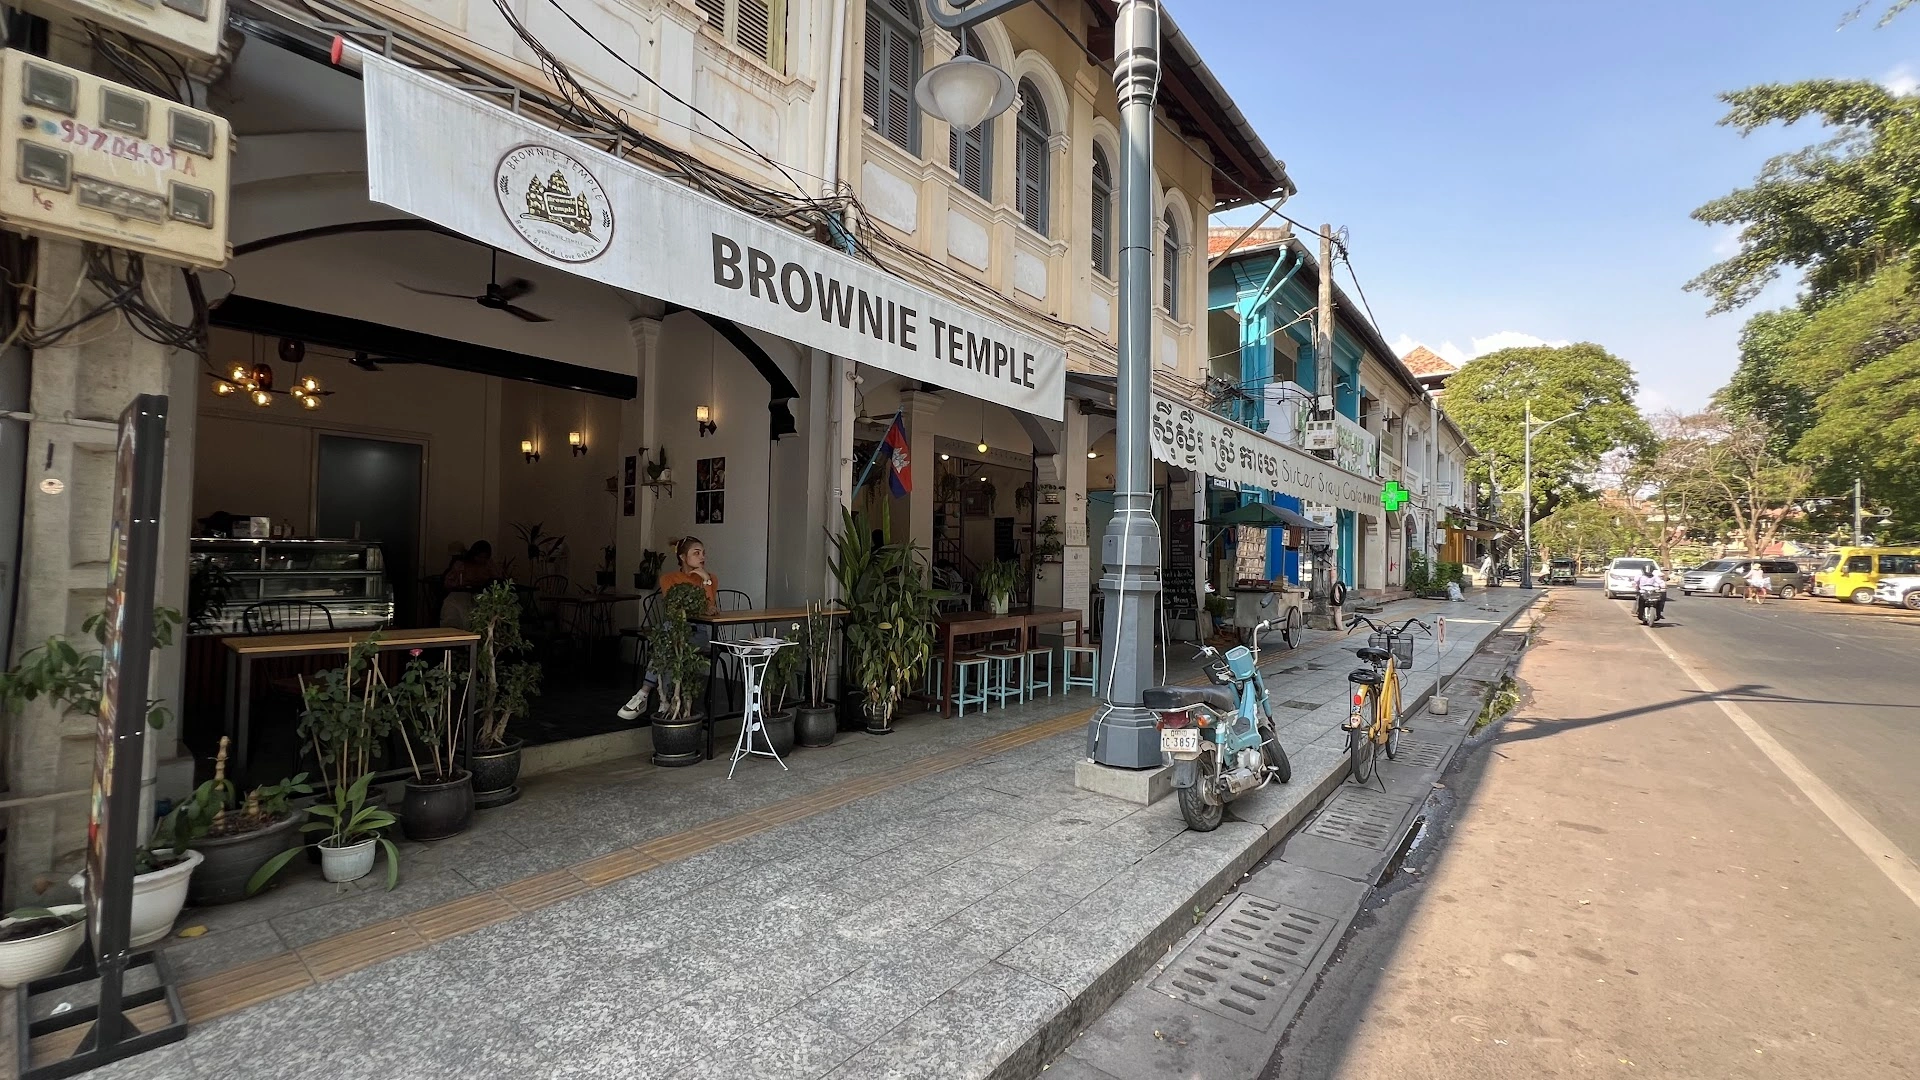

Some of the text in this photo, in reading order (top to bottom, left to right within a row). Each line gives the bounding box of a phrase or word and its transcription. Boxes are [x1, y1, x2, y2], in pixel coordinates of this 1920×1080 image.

[505, 148, 604, 200] BROWNIE TEMPLE
[515, 219, 531, 238] Bake
[533, 236, 556, 255] Blend
[711, 232, 1035, 390] BROWNIE TEMPLE
[1282, 459, 1315, 488] Sister
[1318, 472, 1340, 501] Srey
